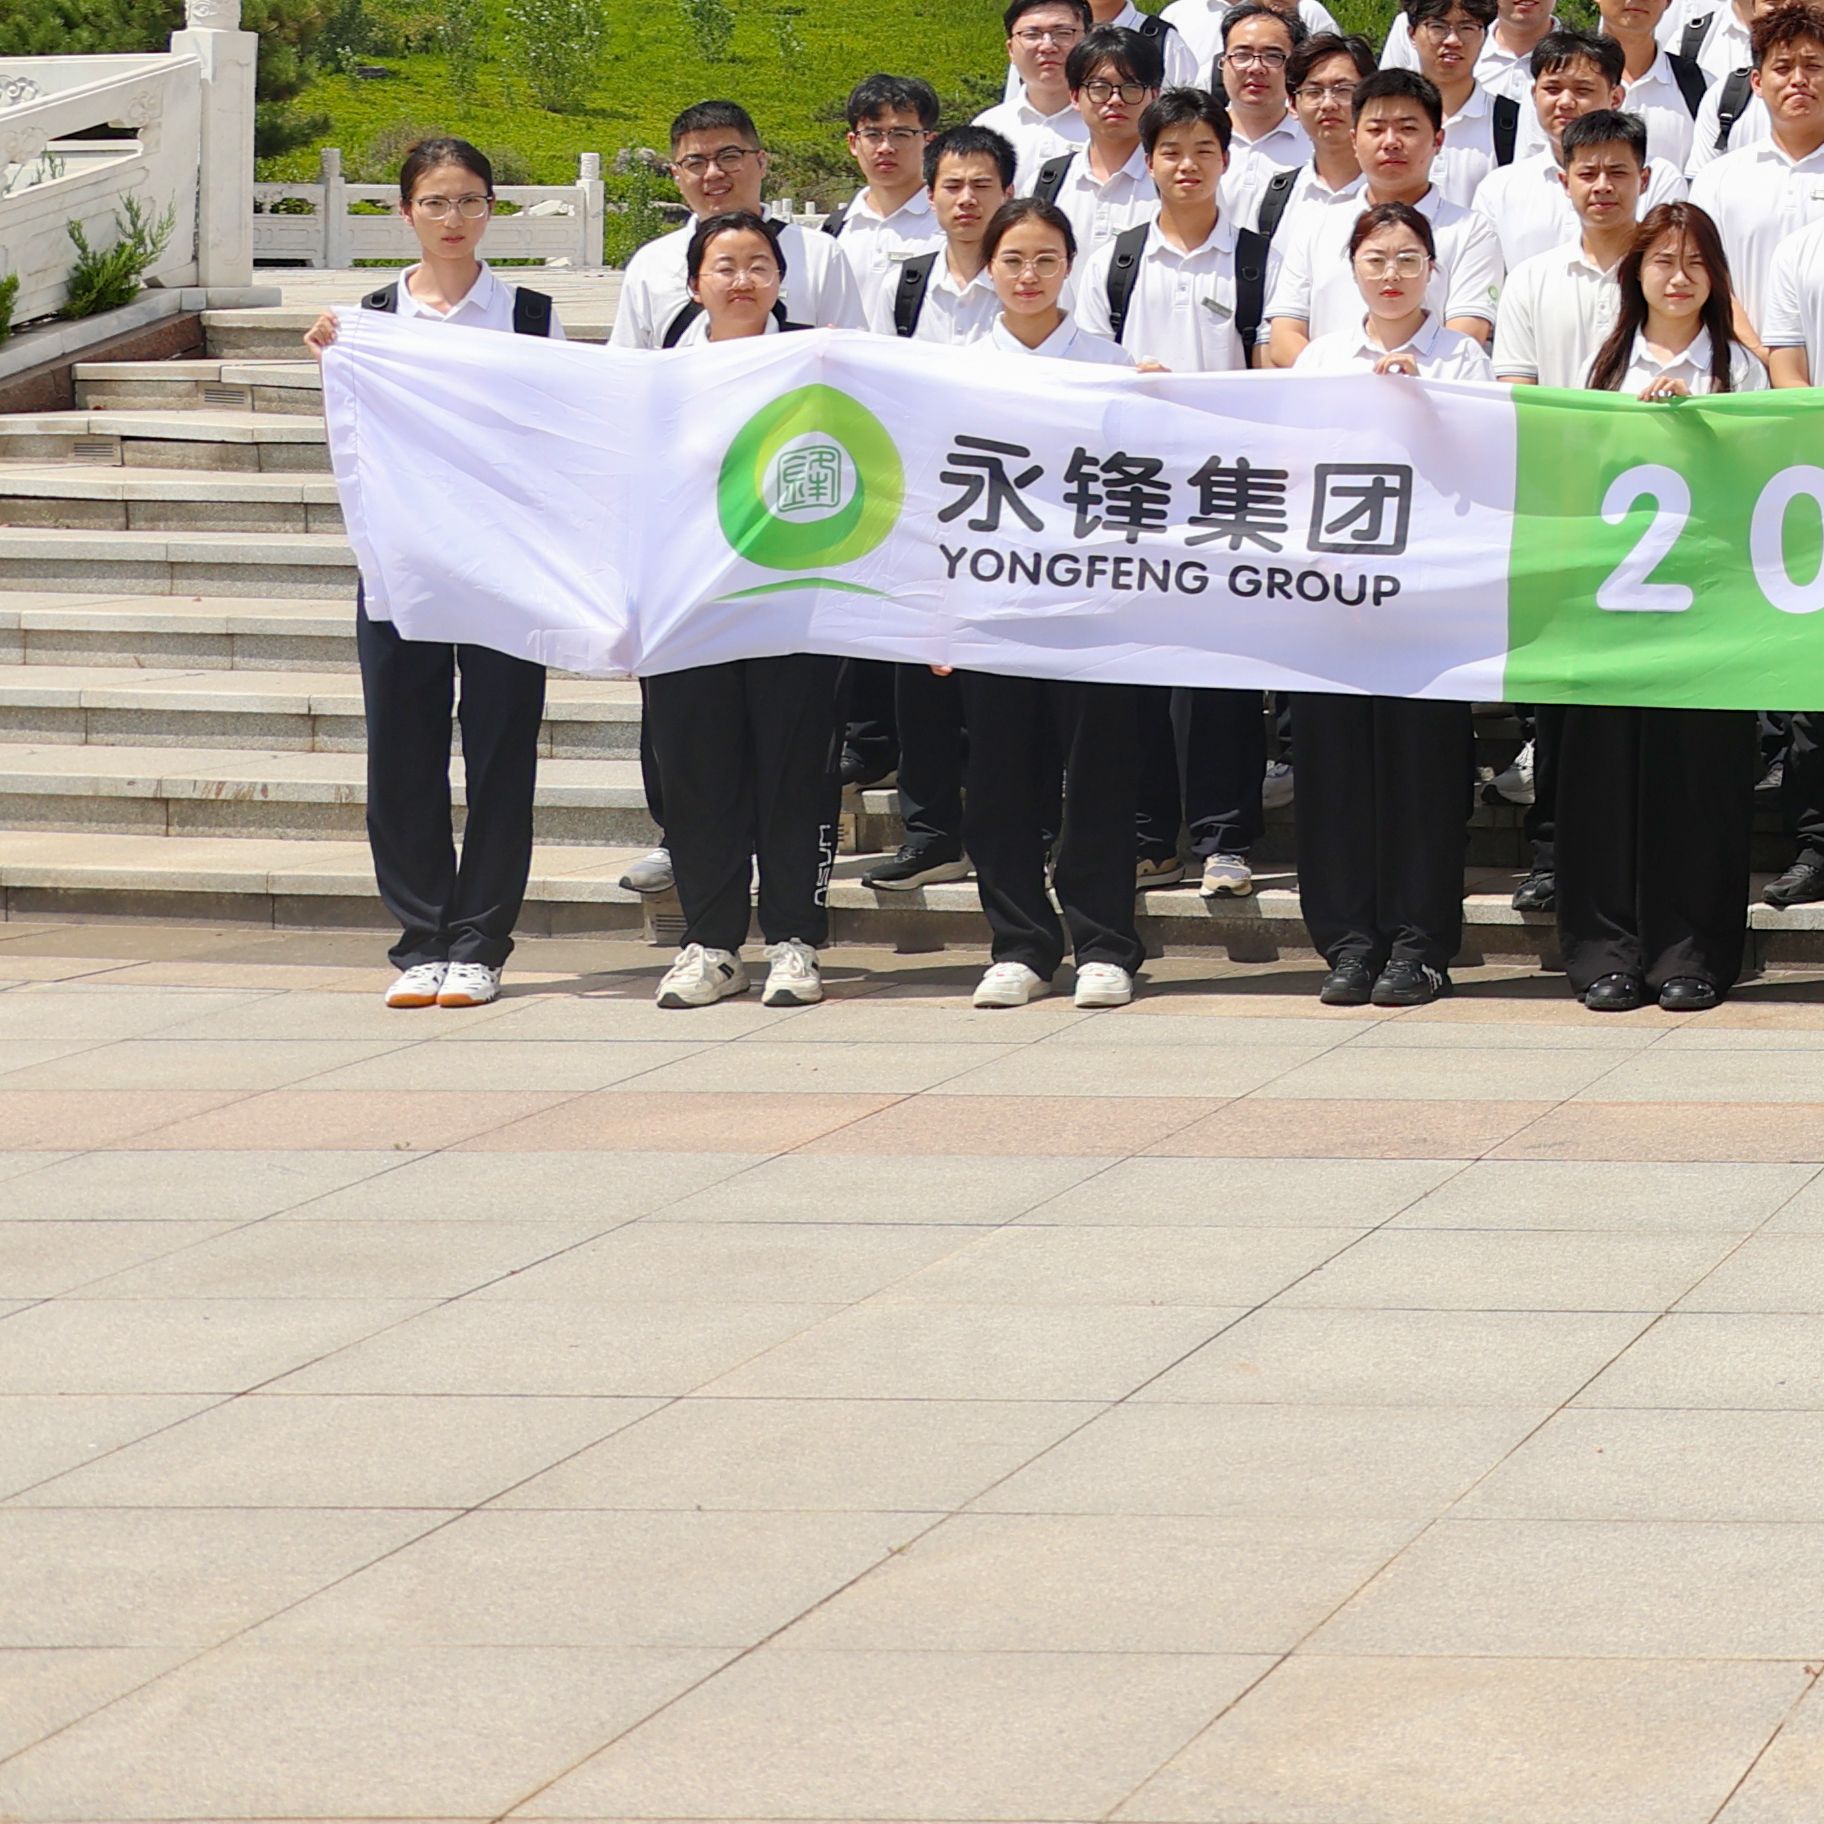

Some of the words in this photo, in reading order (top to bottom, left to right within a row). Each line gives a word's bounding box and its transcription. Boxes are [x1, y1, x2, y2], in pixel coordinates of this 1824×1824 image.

[937, 434, 1413, 556] 永锋集团
[938, 543, 1210, 596] YONGFENG
[1228, 564, 1402, 608] GROUP
